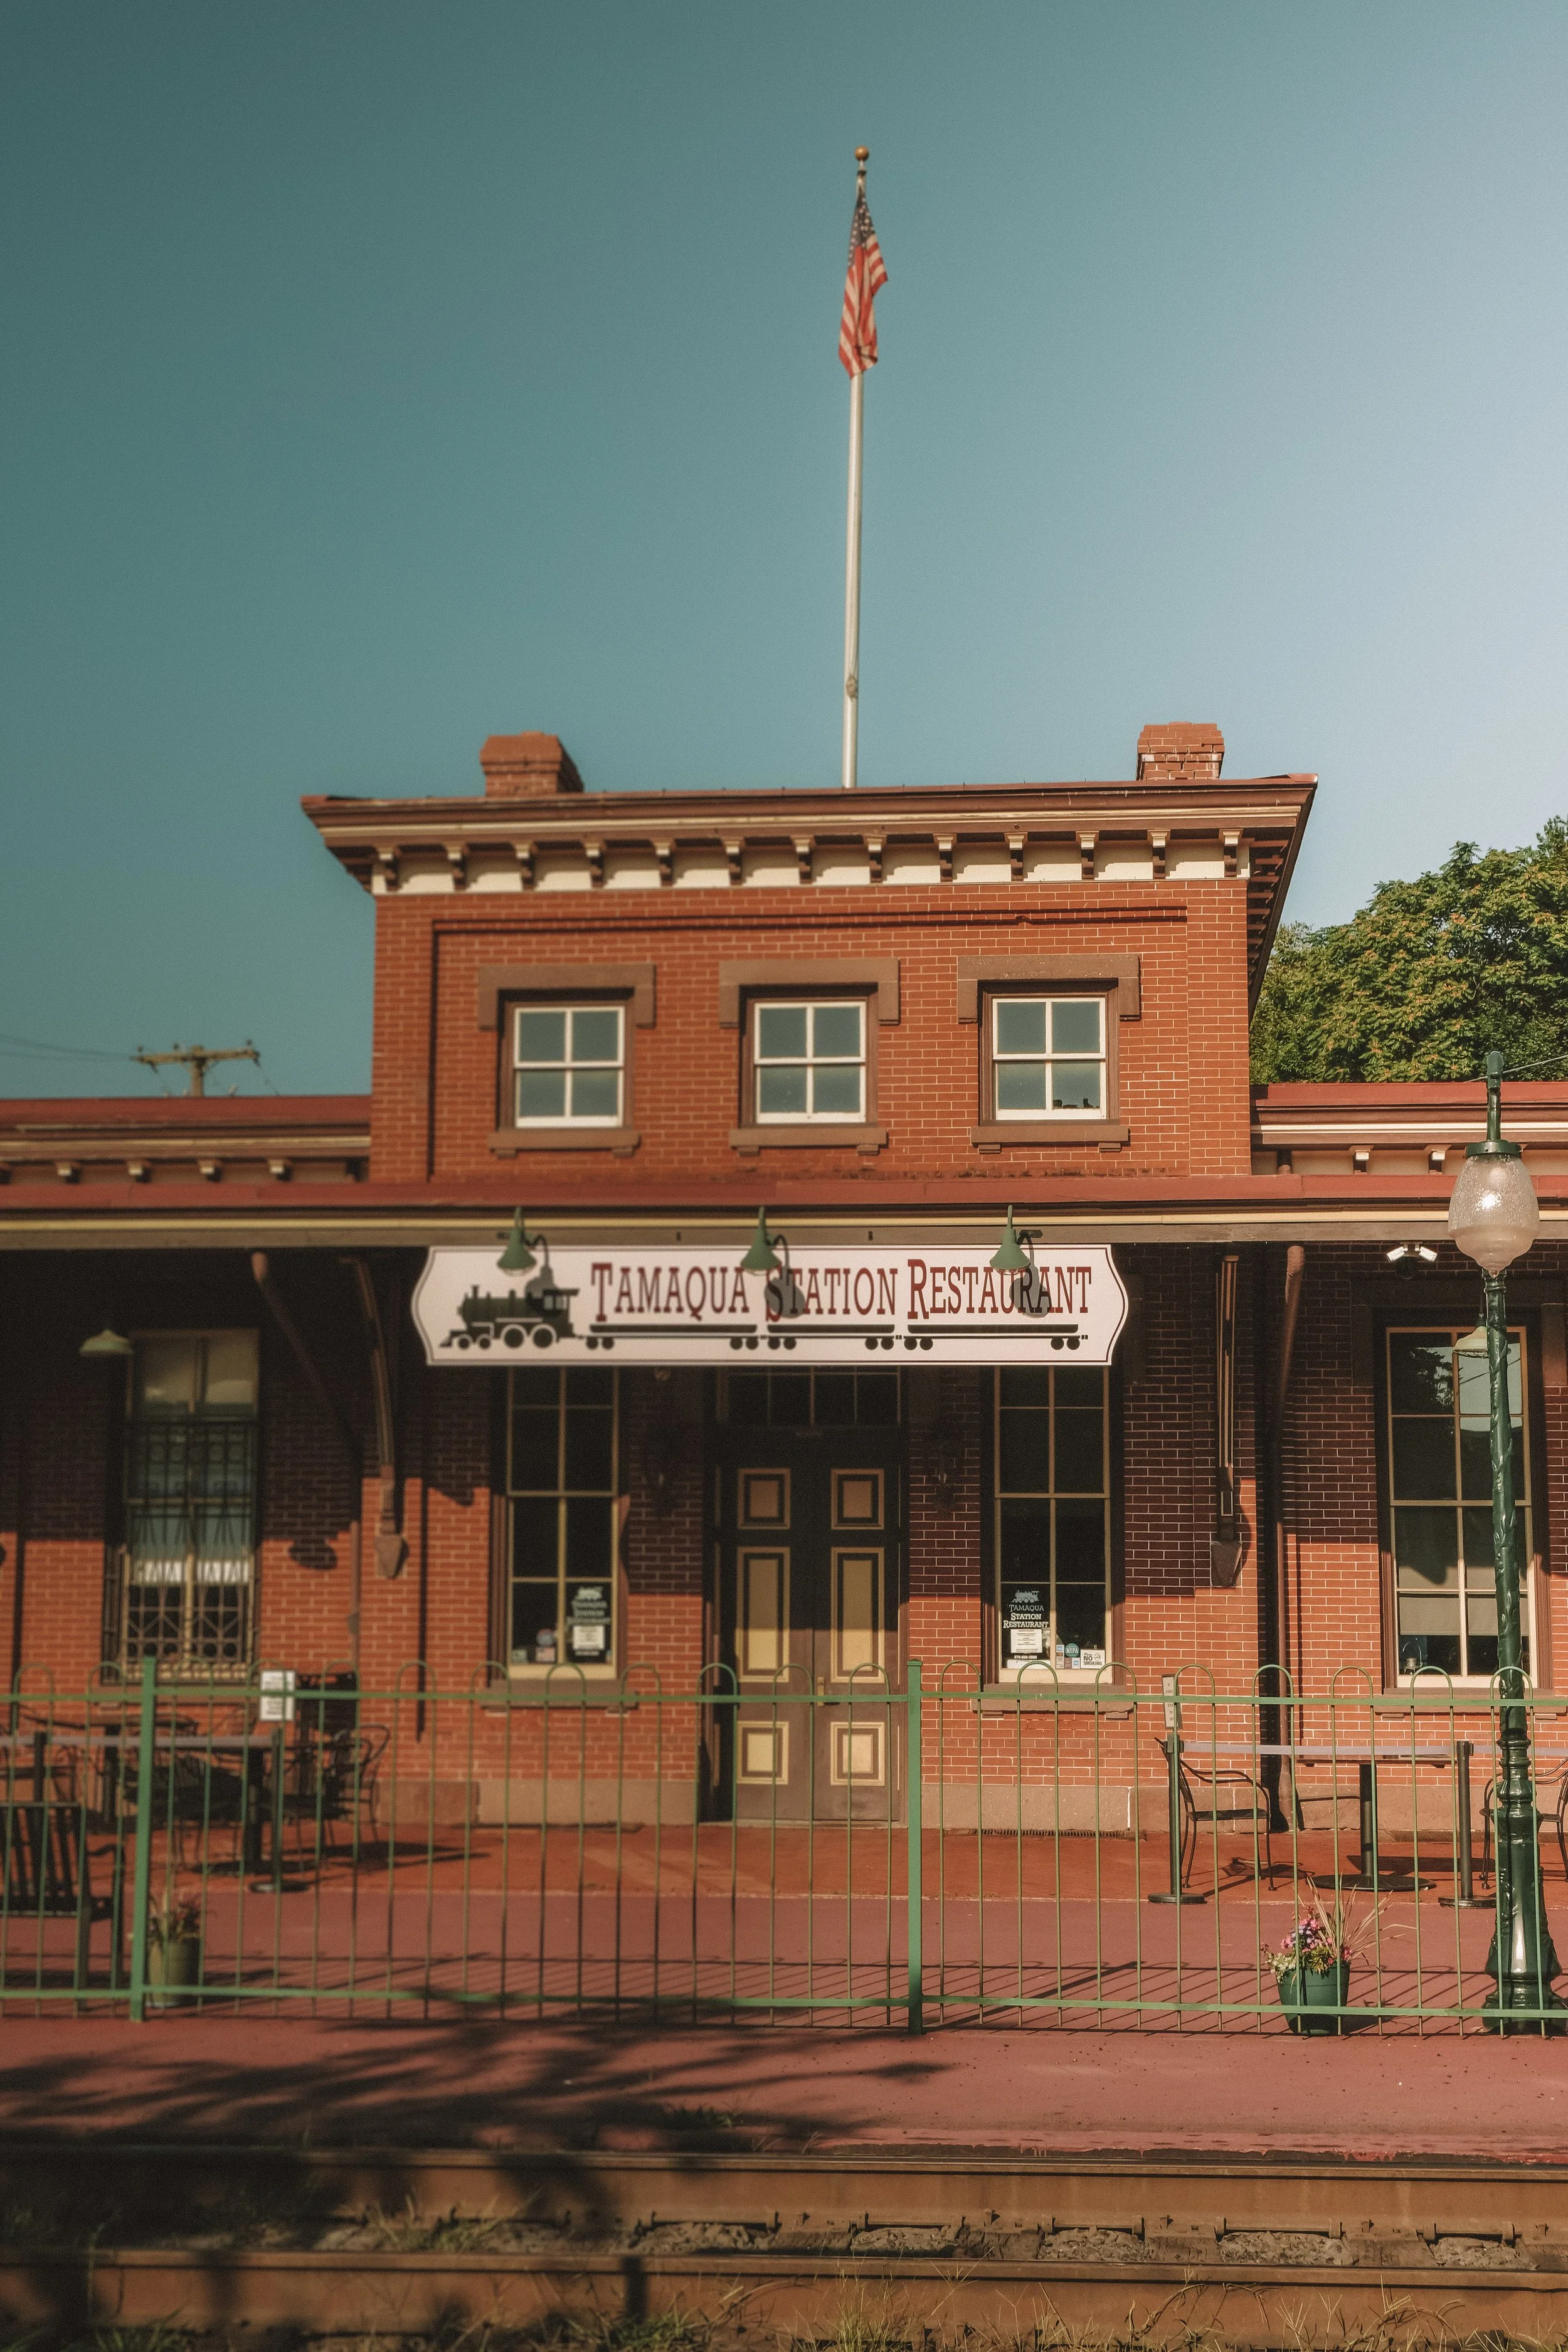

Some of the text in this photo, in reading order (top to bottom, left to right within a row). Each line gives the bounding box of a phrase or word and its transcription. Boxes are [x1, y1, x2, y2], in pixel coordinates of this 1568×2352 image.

[591, 1259, 1092, 1322] TAMAQUA STATION RESTAURANT
[1010, 1613, 1042, 1621] STATION
[1003, 1619, 1049, 1628] RESTAURANT
